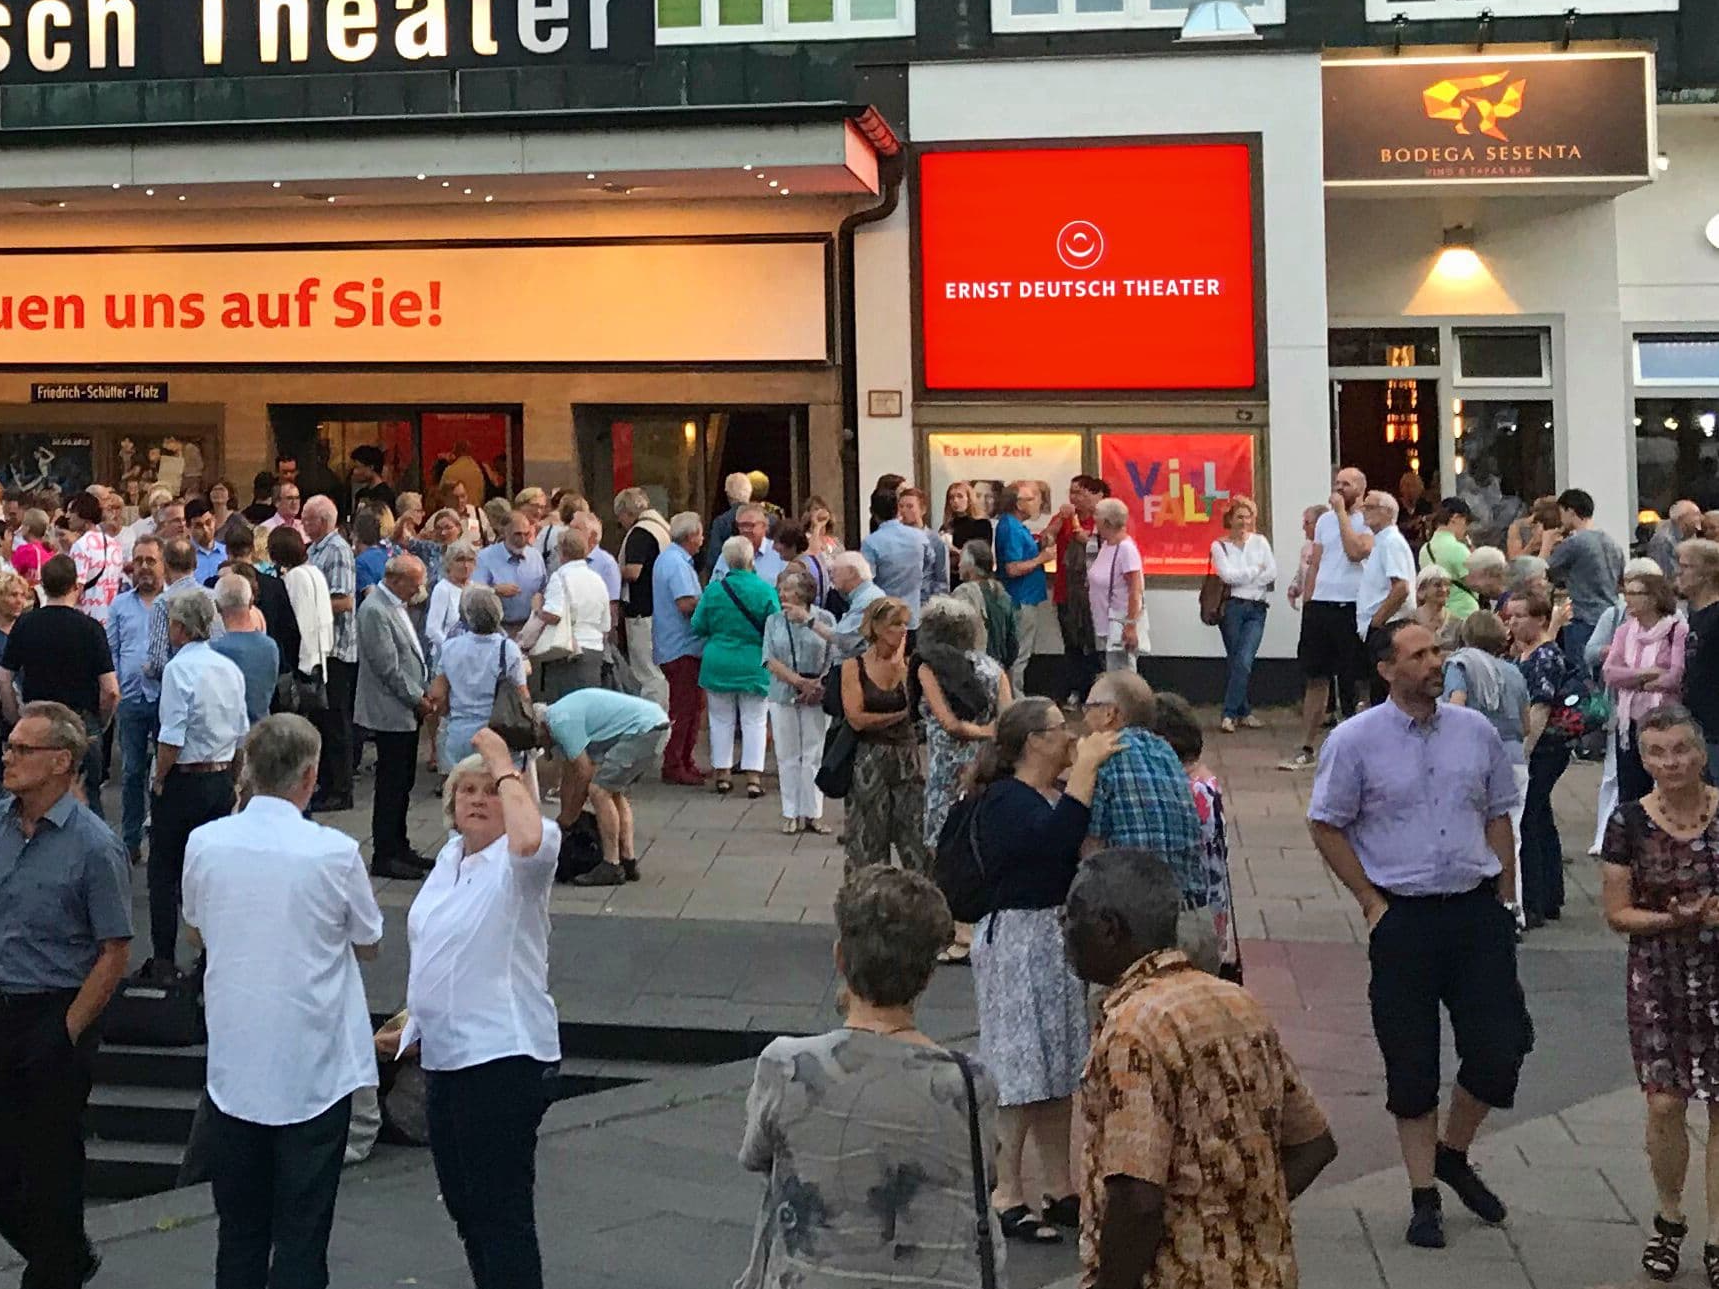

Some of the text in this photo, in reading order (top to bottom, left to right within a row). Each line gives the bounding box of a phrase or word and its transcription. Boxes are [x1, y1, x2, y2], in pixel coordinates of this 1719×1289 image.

[1381, 145, 1582, 163] BODEGA SESENTA
[945, 279, 1220, 299] ERNST DEUTSCH THEATER
[105, 293, 205, 329] uns
[221, 277, 320, 329] auf
[333, 277, 442, 328] Sie!
[944, 444, 1032, 457] Es wird Zeit
